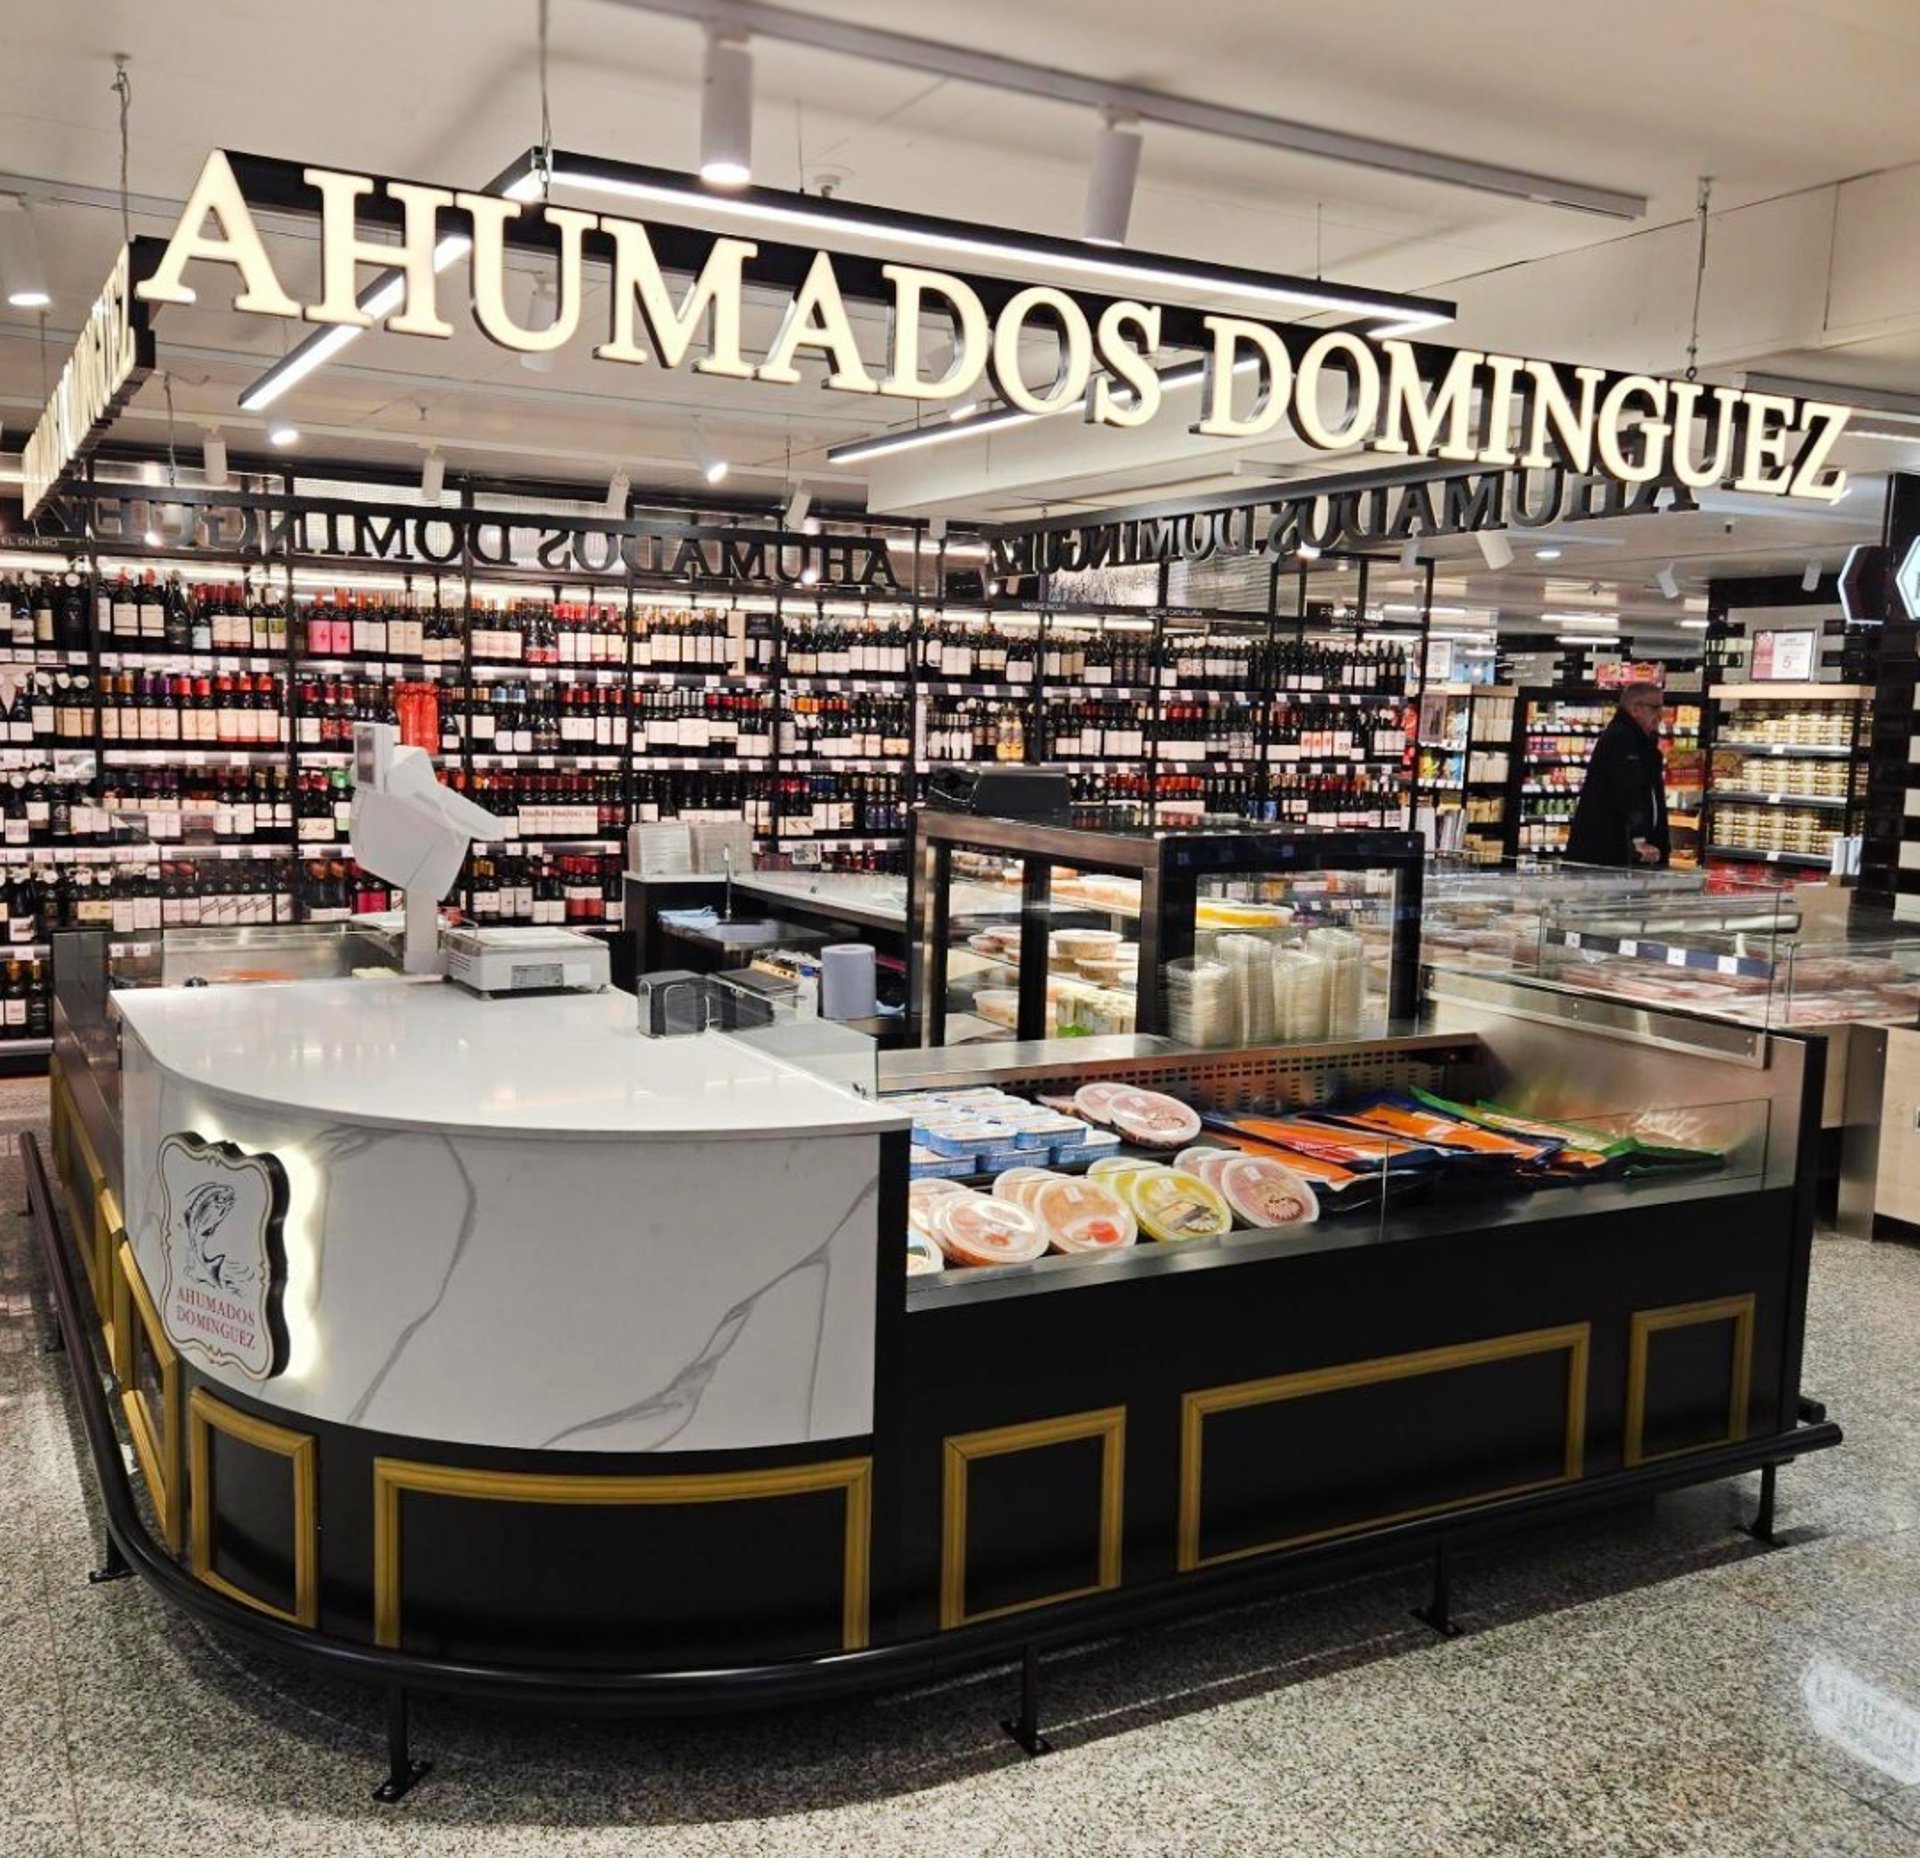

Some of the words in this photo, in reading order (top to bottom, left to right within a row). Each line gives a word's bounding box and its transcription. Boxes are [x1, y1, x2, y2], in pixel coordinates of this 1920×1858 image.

[137, 149, 1161, 427] AHUMADOS
[1189, 315, 1851, 505] DOMINGUEZ
[176, 1305, 256, 1349] DOMINGUEZ
[178, 1287, 255, 1327] AHUMADOS
